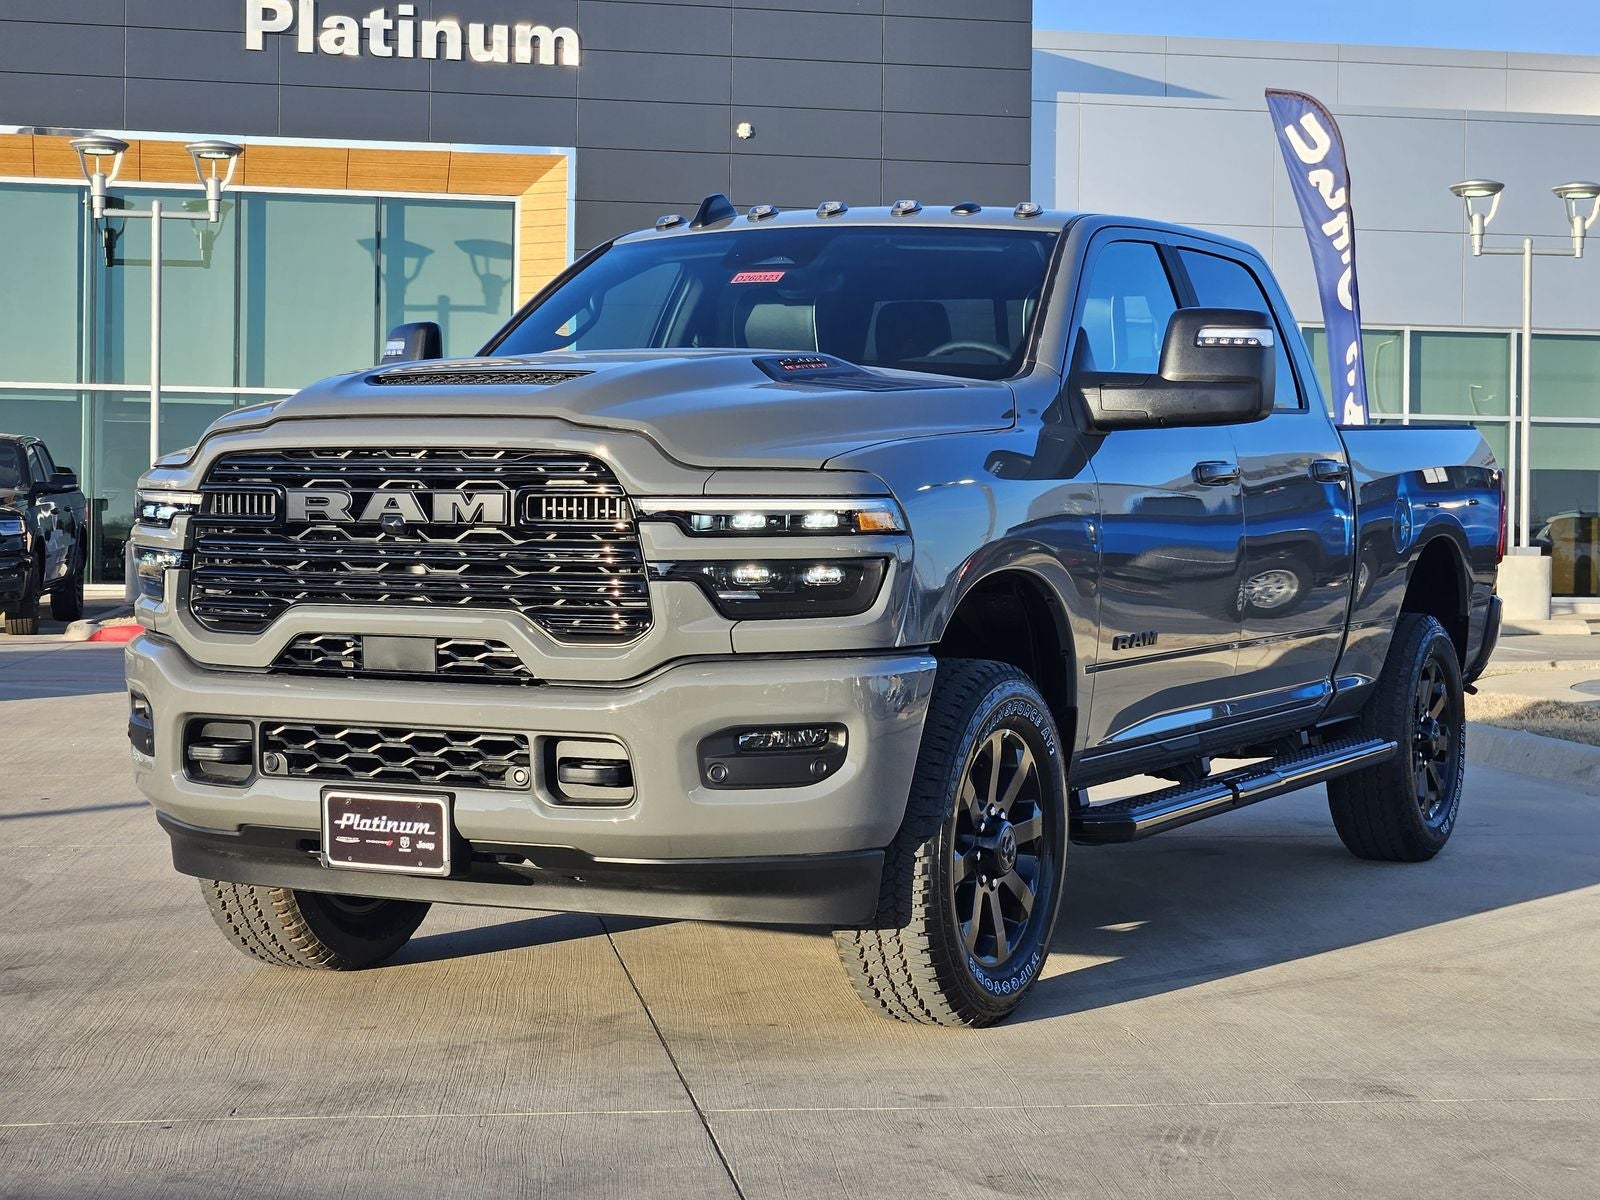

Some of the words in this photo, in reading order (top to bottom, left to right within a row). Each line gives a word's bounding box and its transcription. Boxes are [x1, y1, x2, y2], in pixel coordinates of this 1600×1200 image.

[245, 0, 580, 66] Platinum
[286, 490, 508, 526] RAM
[1112, 630, 1158, 650] RAM
[334, 812, 436, 835] Platinum
[416, 840, 435, 851] Jeep
[968, 952, 1040, 995] Firestone
